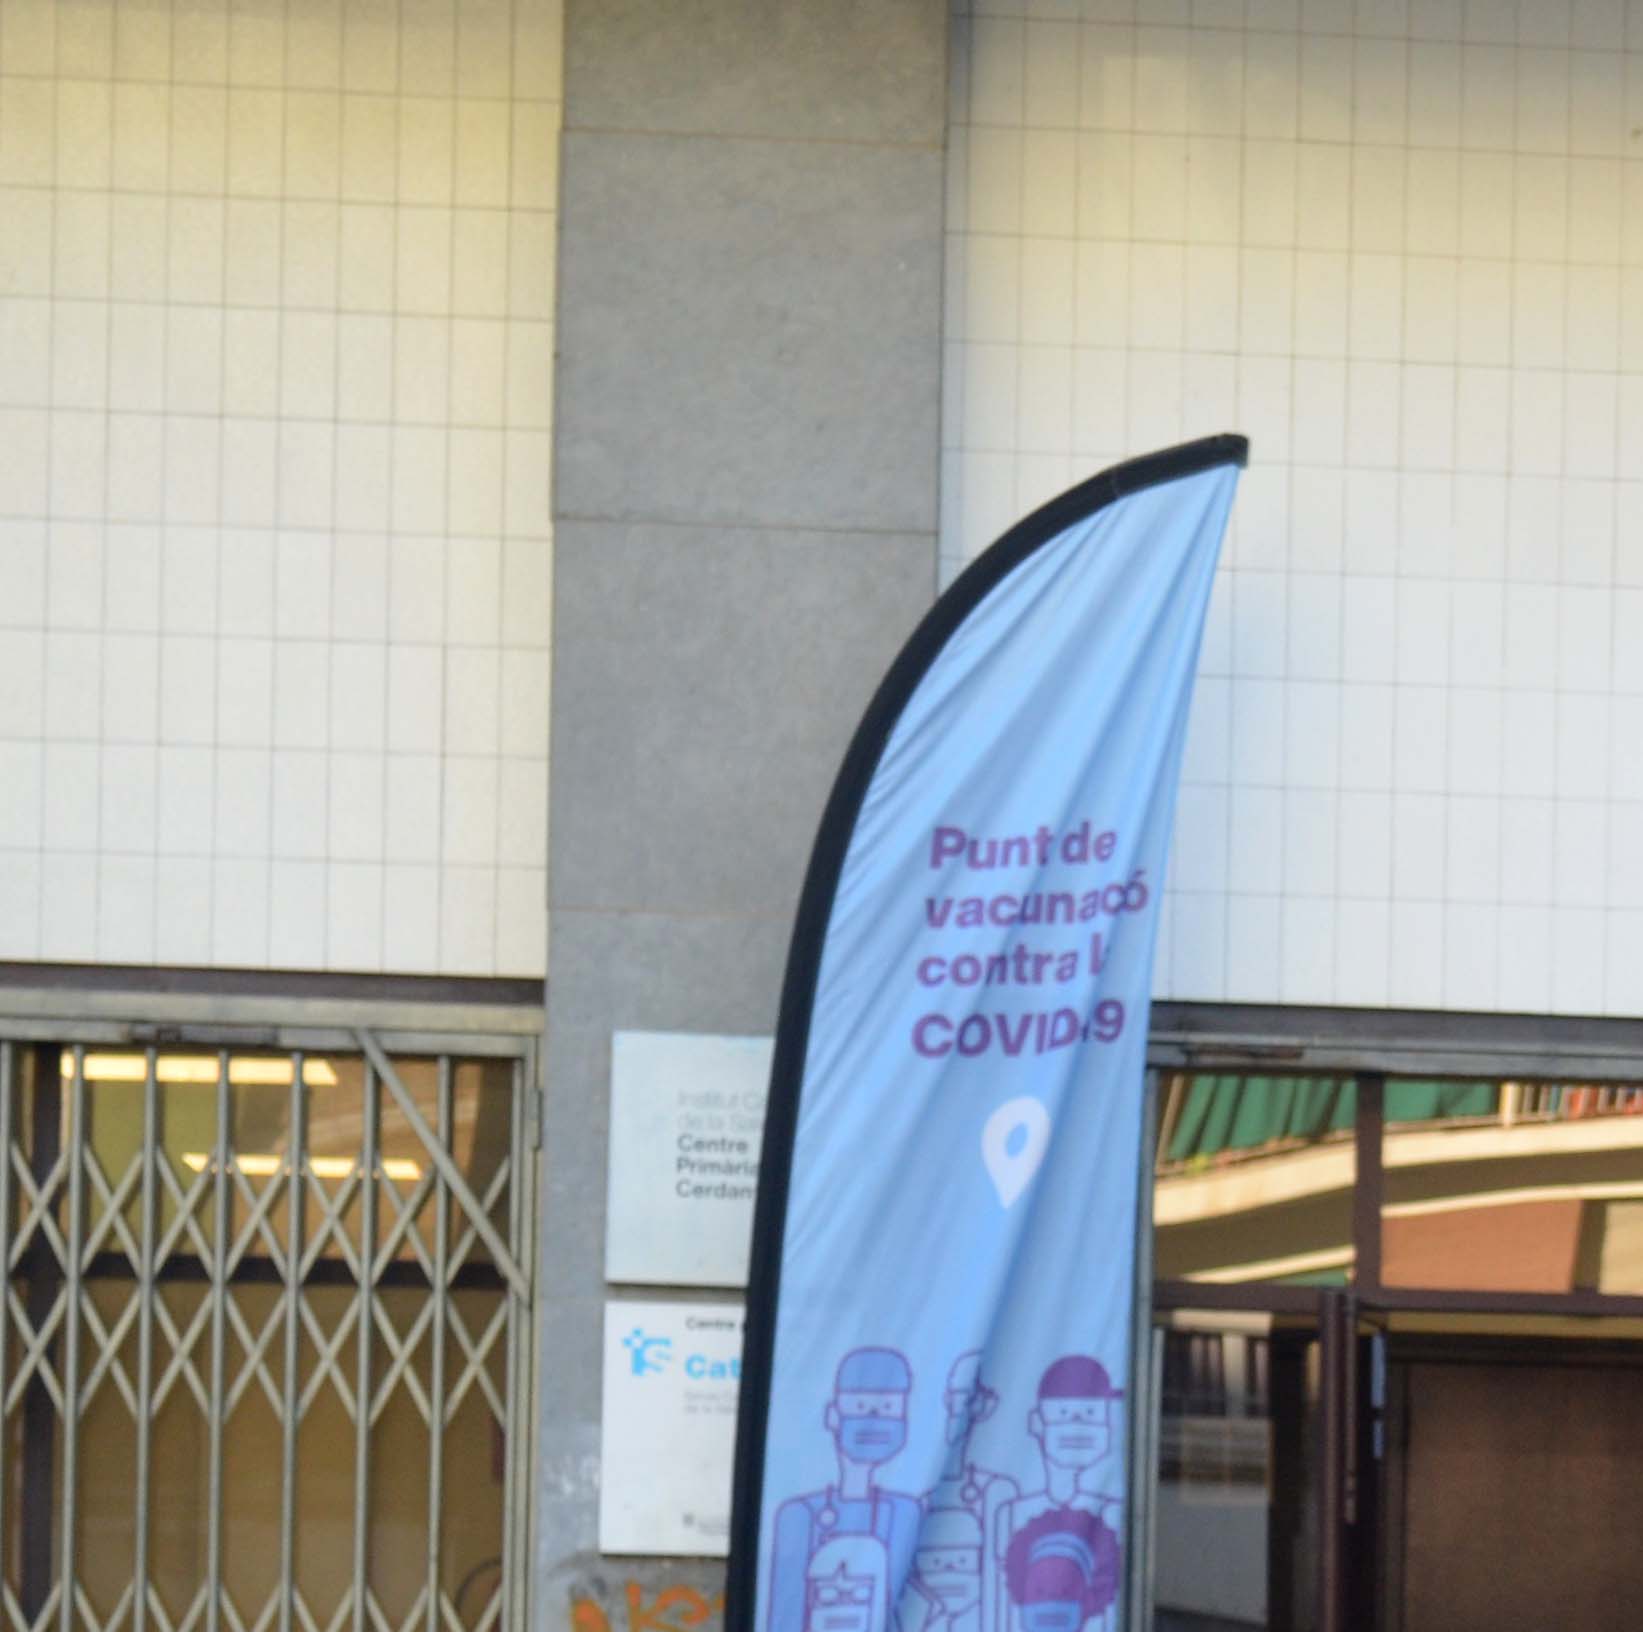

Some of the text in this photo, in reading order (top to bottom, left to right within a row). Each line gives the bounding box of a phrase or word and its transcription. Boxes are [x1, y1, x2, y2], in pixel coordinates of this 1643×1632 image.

[929, 820, 1117, 870] Punt de
[924, 868, 1150, 929] vacunacó
[916, 932, 1104, 987] contra l
[677, 1133, 749, 1155] Centre
